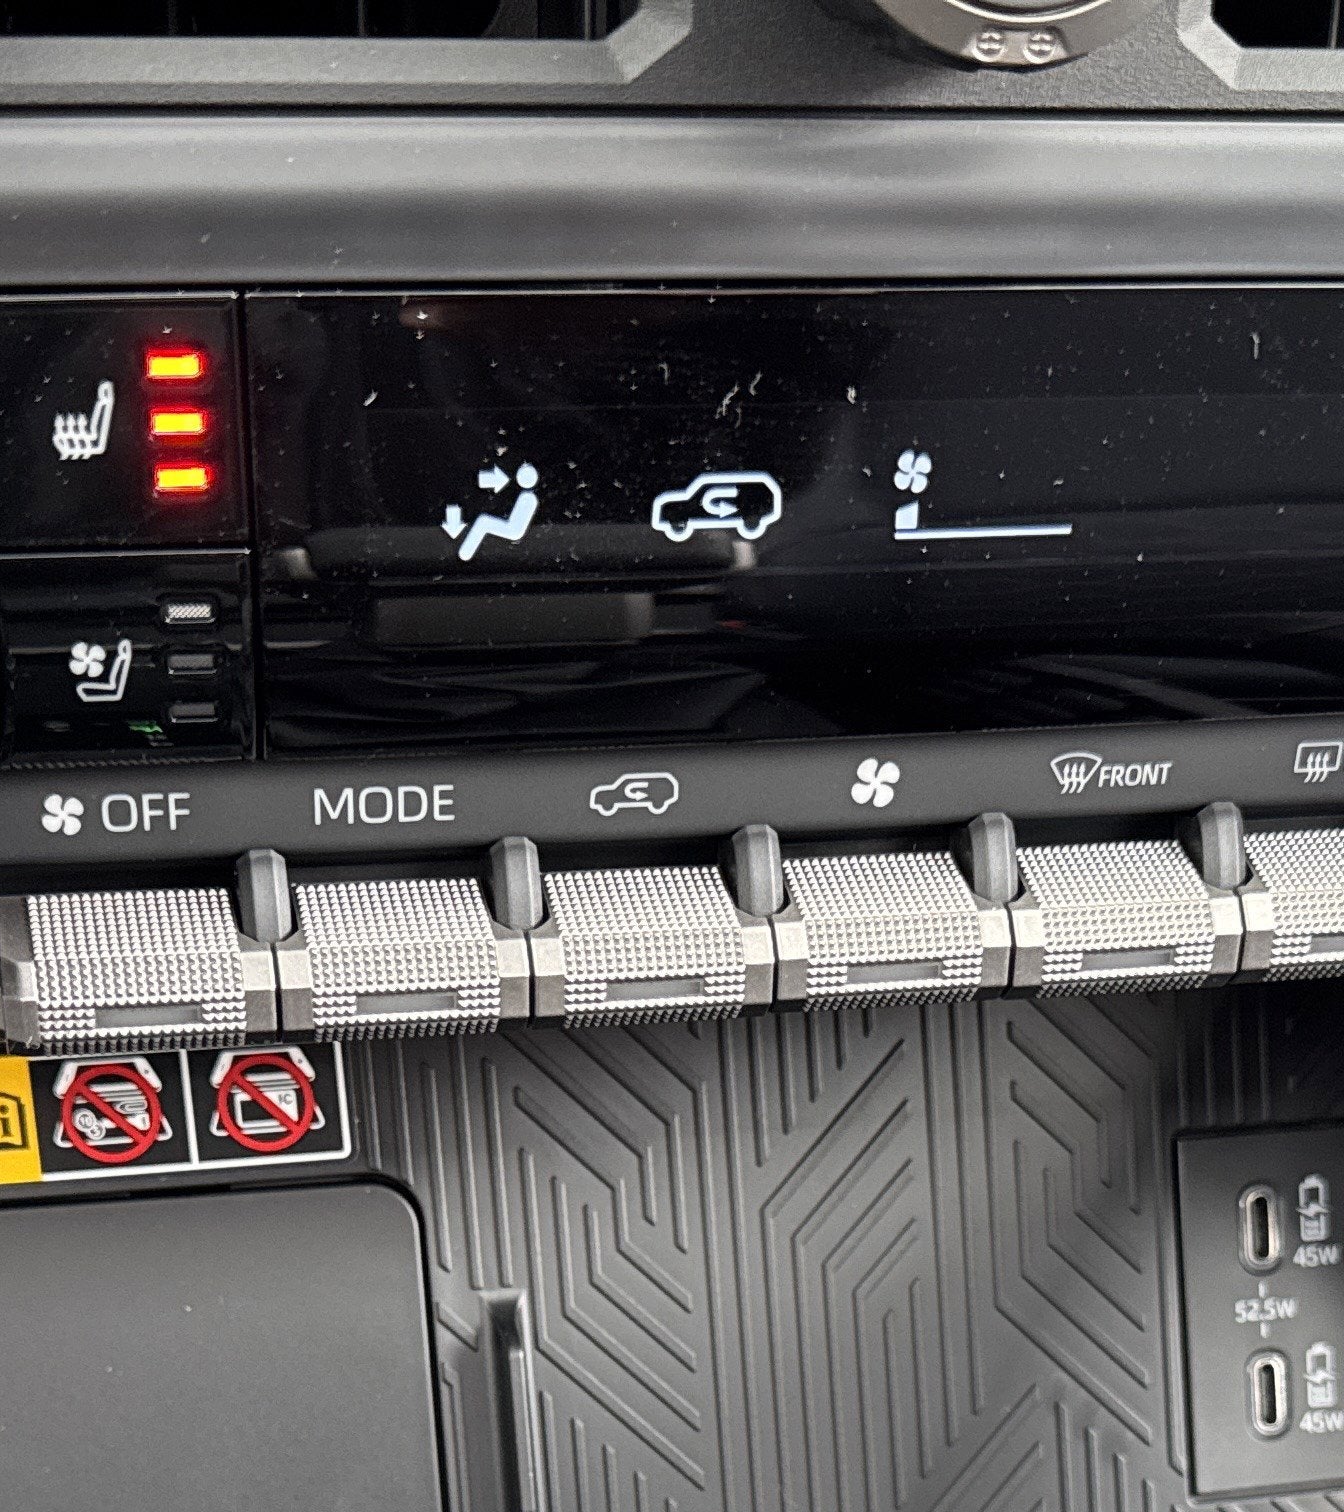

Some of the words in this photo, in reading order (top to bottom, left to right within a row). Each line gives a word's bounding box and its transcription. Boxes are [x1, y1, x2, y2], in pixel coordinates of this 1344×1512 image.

[1096, 760, 1174, 789] FRONT
[101, 791, 191, 834] OFF
[313, 784, 456, 826] MODE
[1292, 1244, 1341, 1268] 45W
